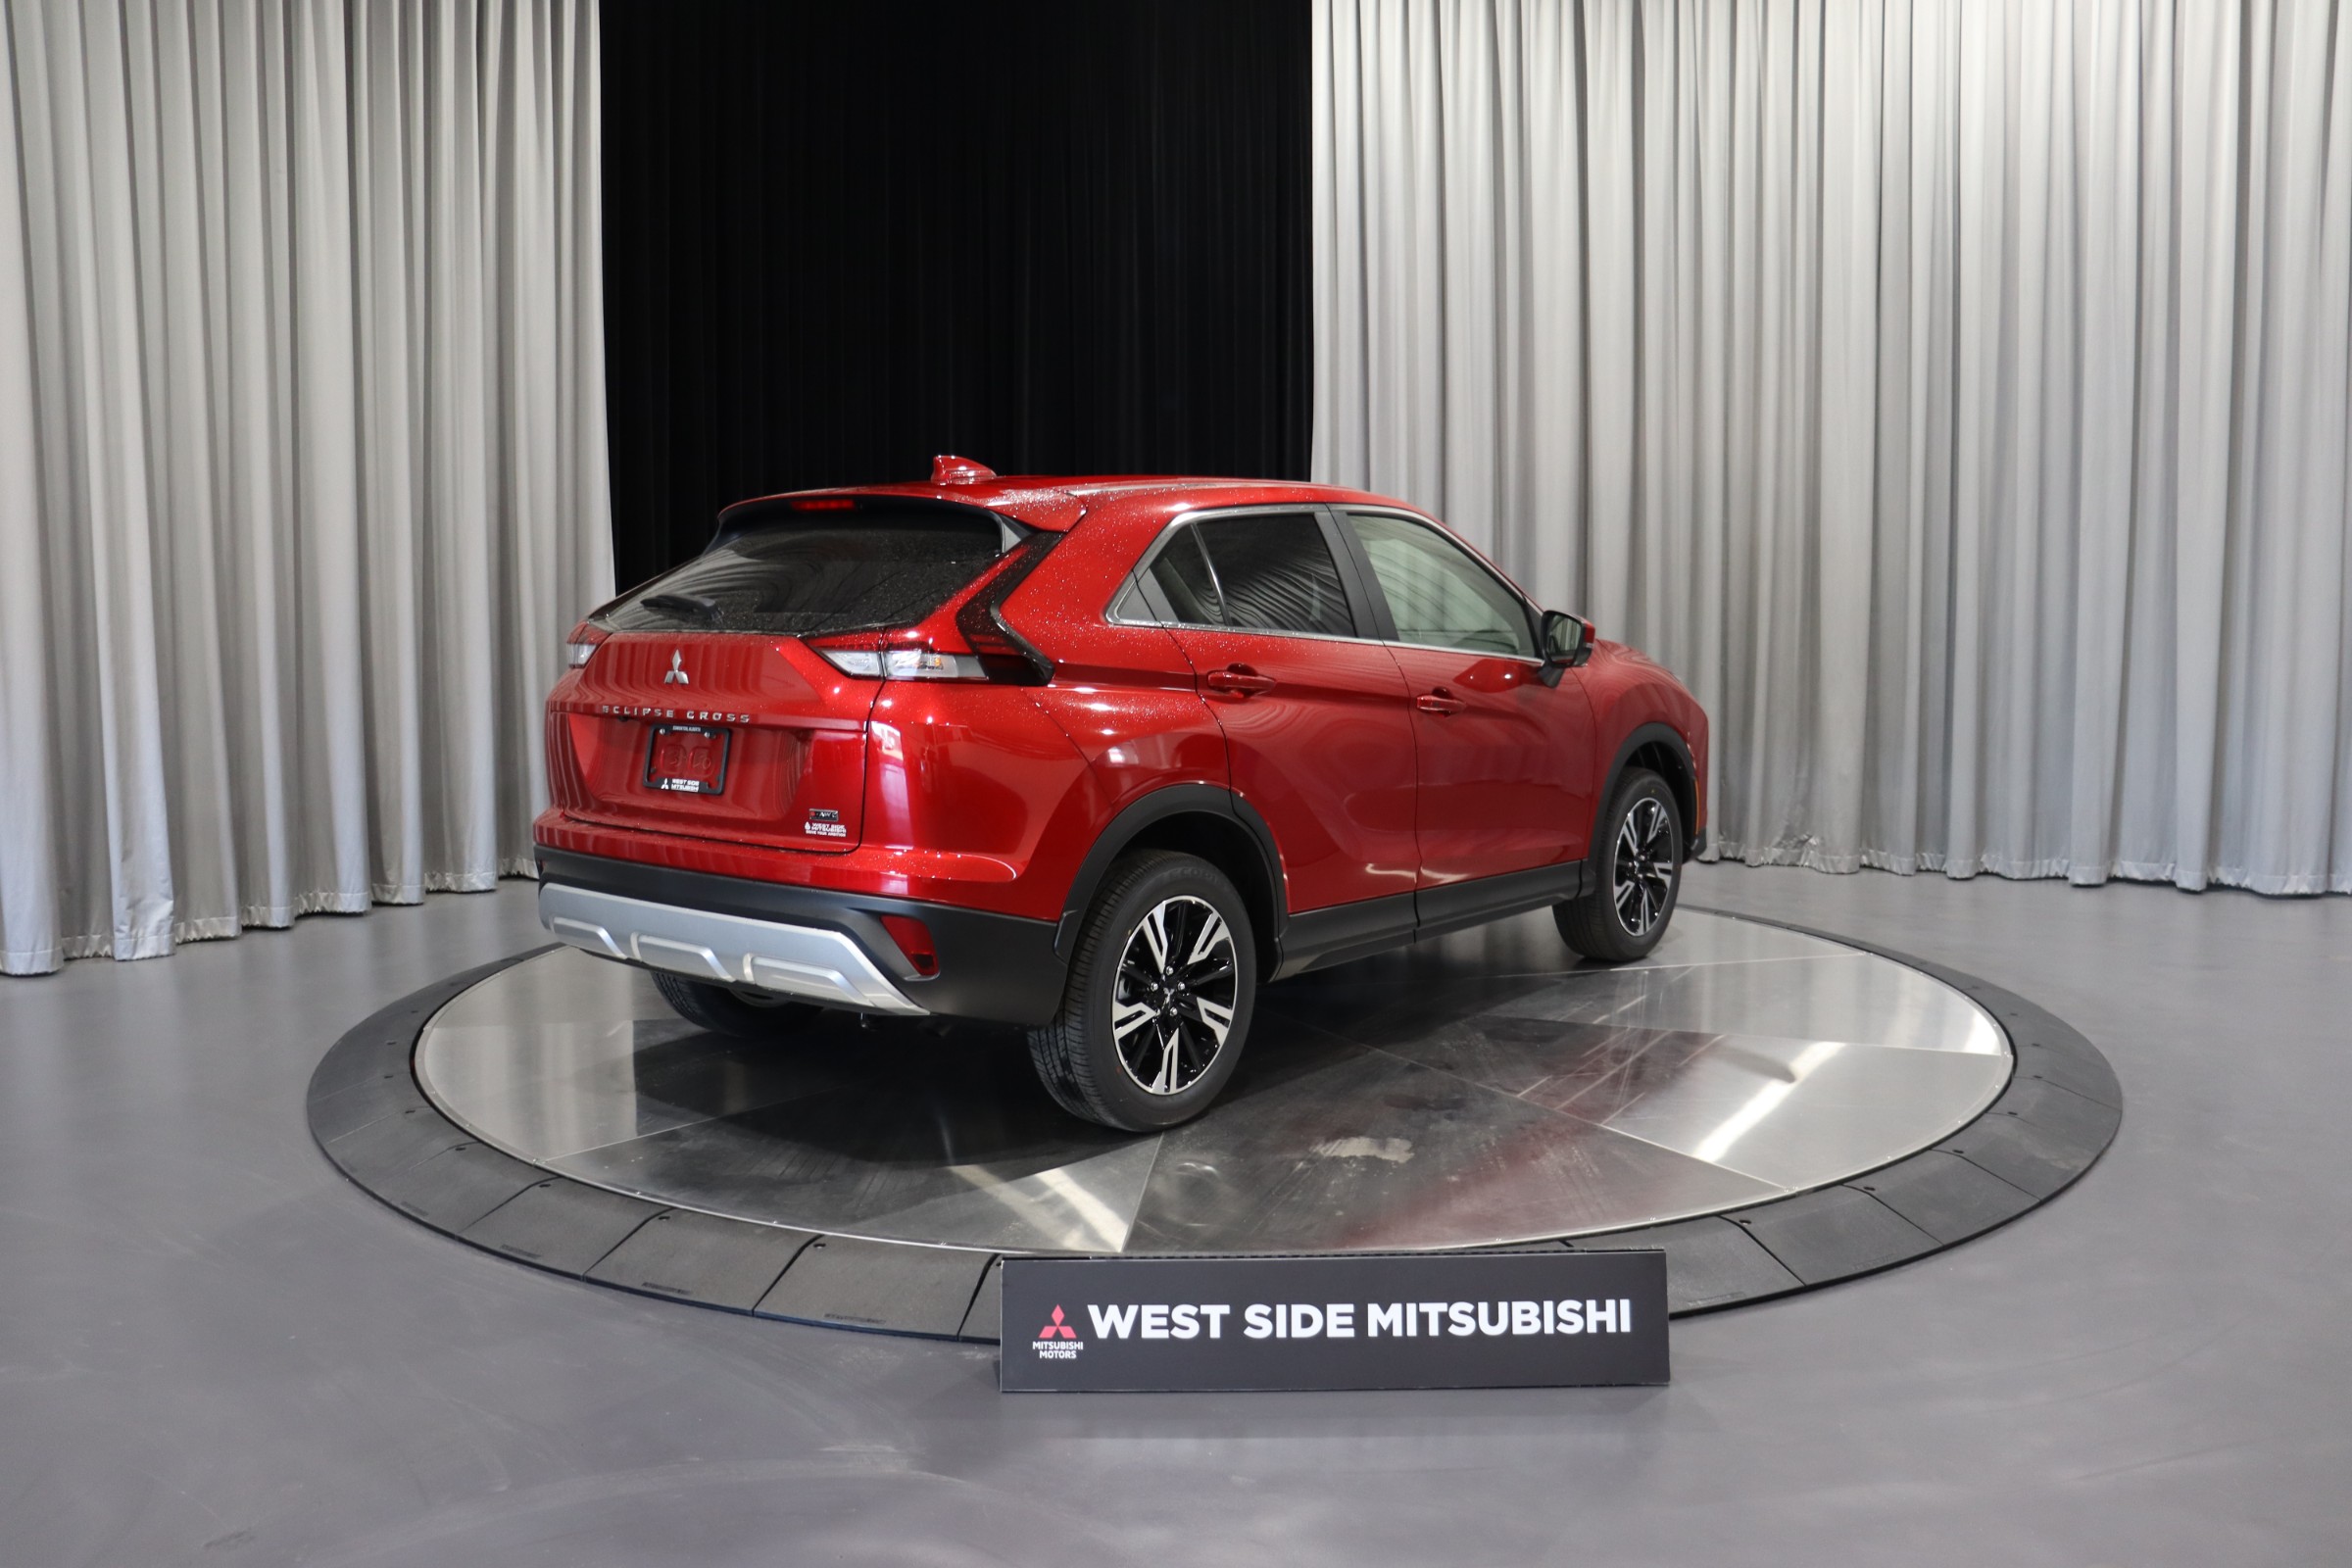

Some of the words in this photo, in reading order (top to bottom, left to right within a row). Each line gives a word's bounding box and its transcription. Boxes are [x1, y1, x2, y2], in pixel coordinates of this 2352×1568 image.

[602, 705, 674, 717] ECLIPSE
[686, 710, 750, 723] CROSS
[1087, 1303, 1230, 1340] WEST
[1244, 1303, 1355, 1340] SIDE
[1368, 1298, 1632, 1337] MITSUBISHI
[1032, 1341, 1084, 1350] MITSUBISHI
[1039, 1350, 1077, 1359] MOTORS
